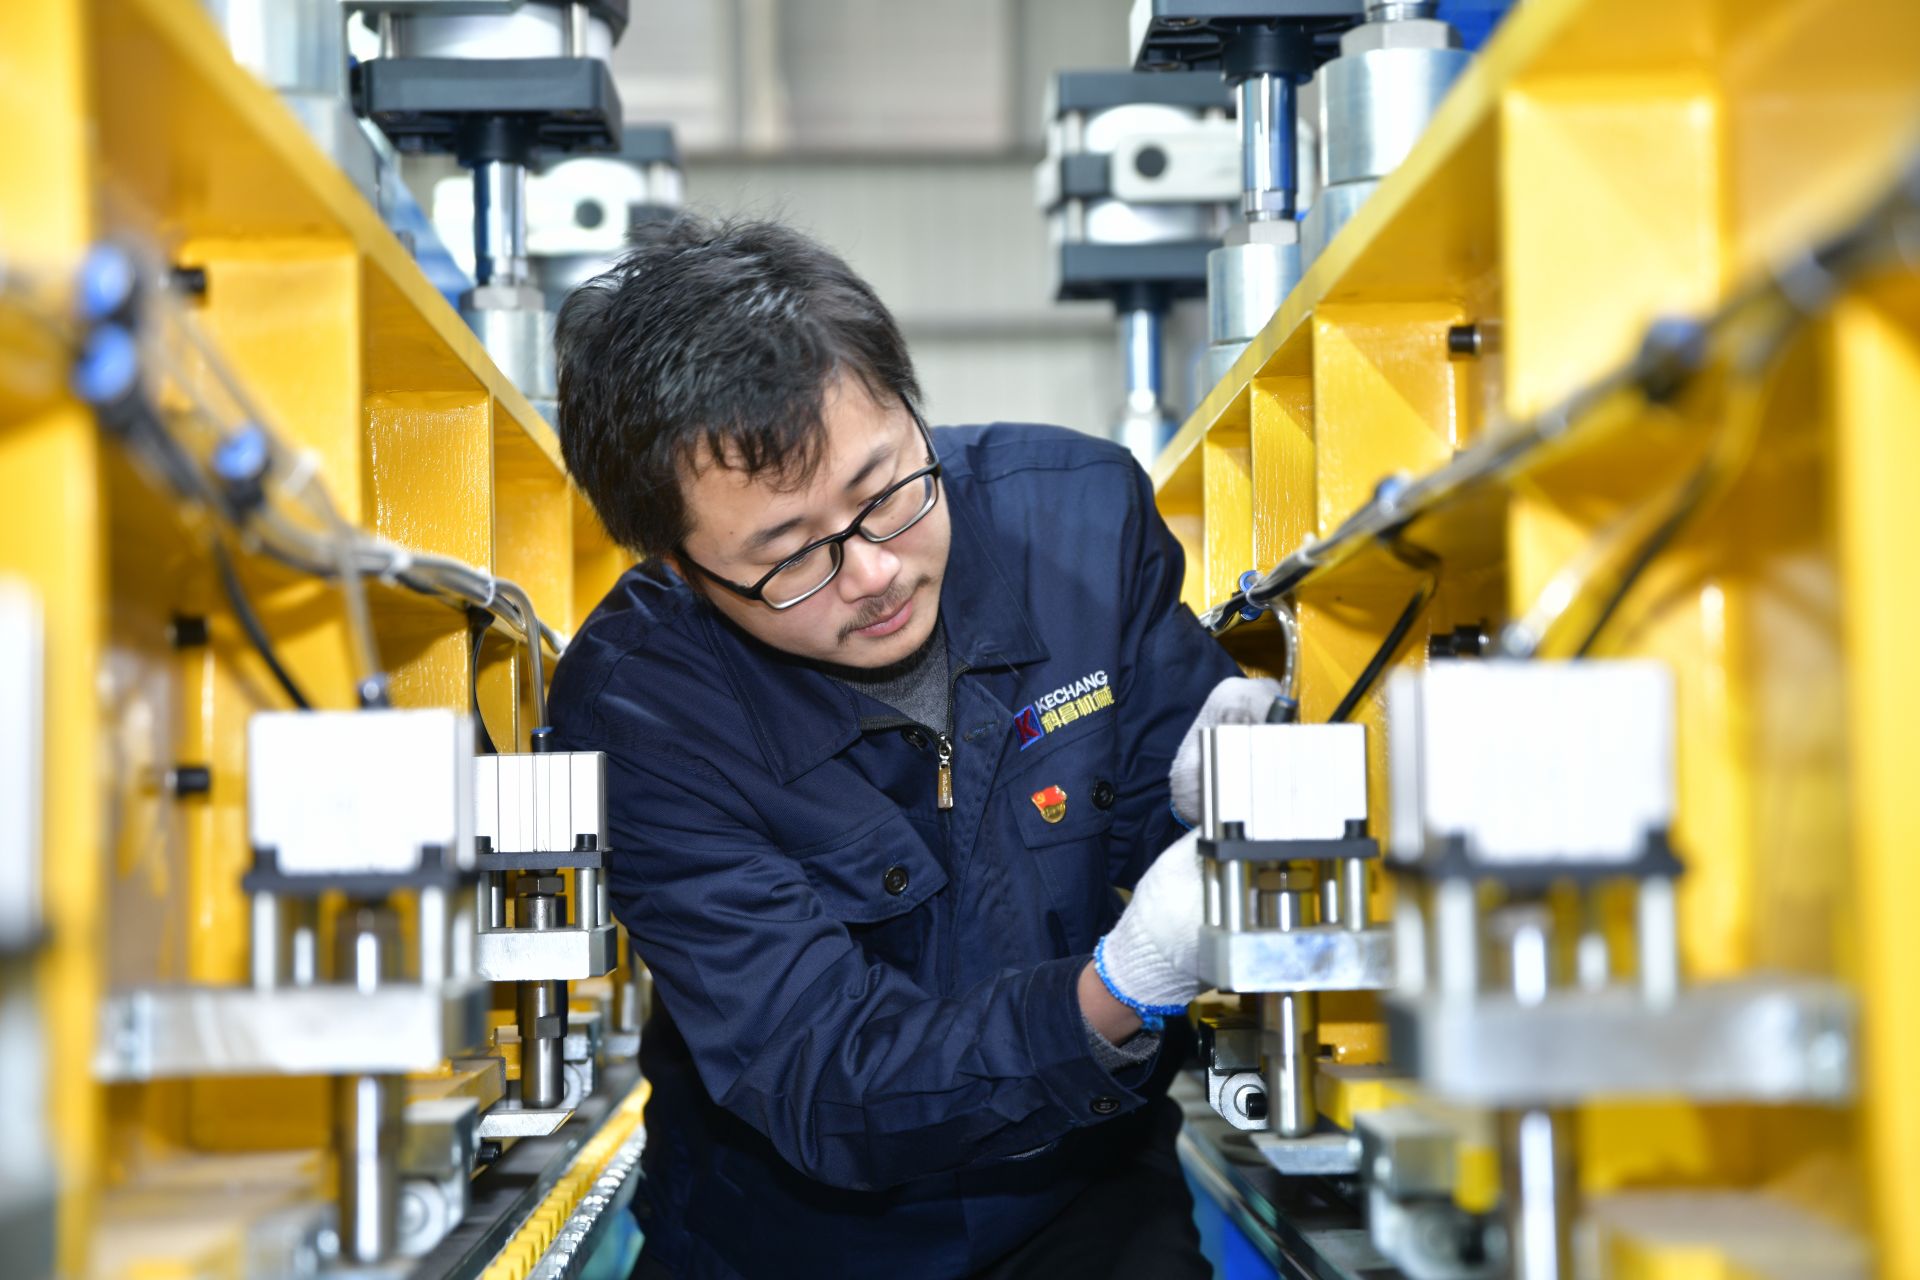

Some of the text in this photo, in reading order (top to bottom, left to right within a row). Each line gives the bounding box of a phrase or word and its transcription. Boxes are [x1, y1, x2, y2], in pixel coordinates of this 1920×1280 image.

[1034, 670, 1108, 715] KECHANG
[1041, 685, 1115, 734] 科昌机械
[1014, 707, 1040, 744] K
